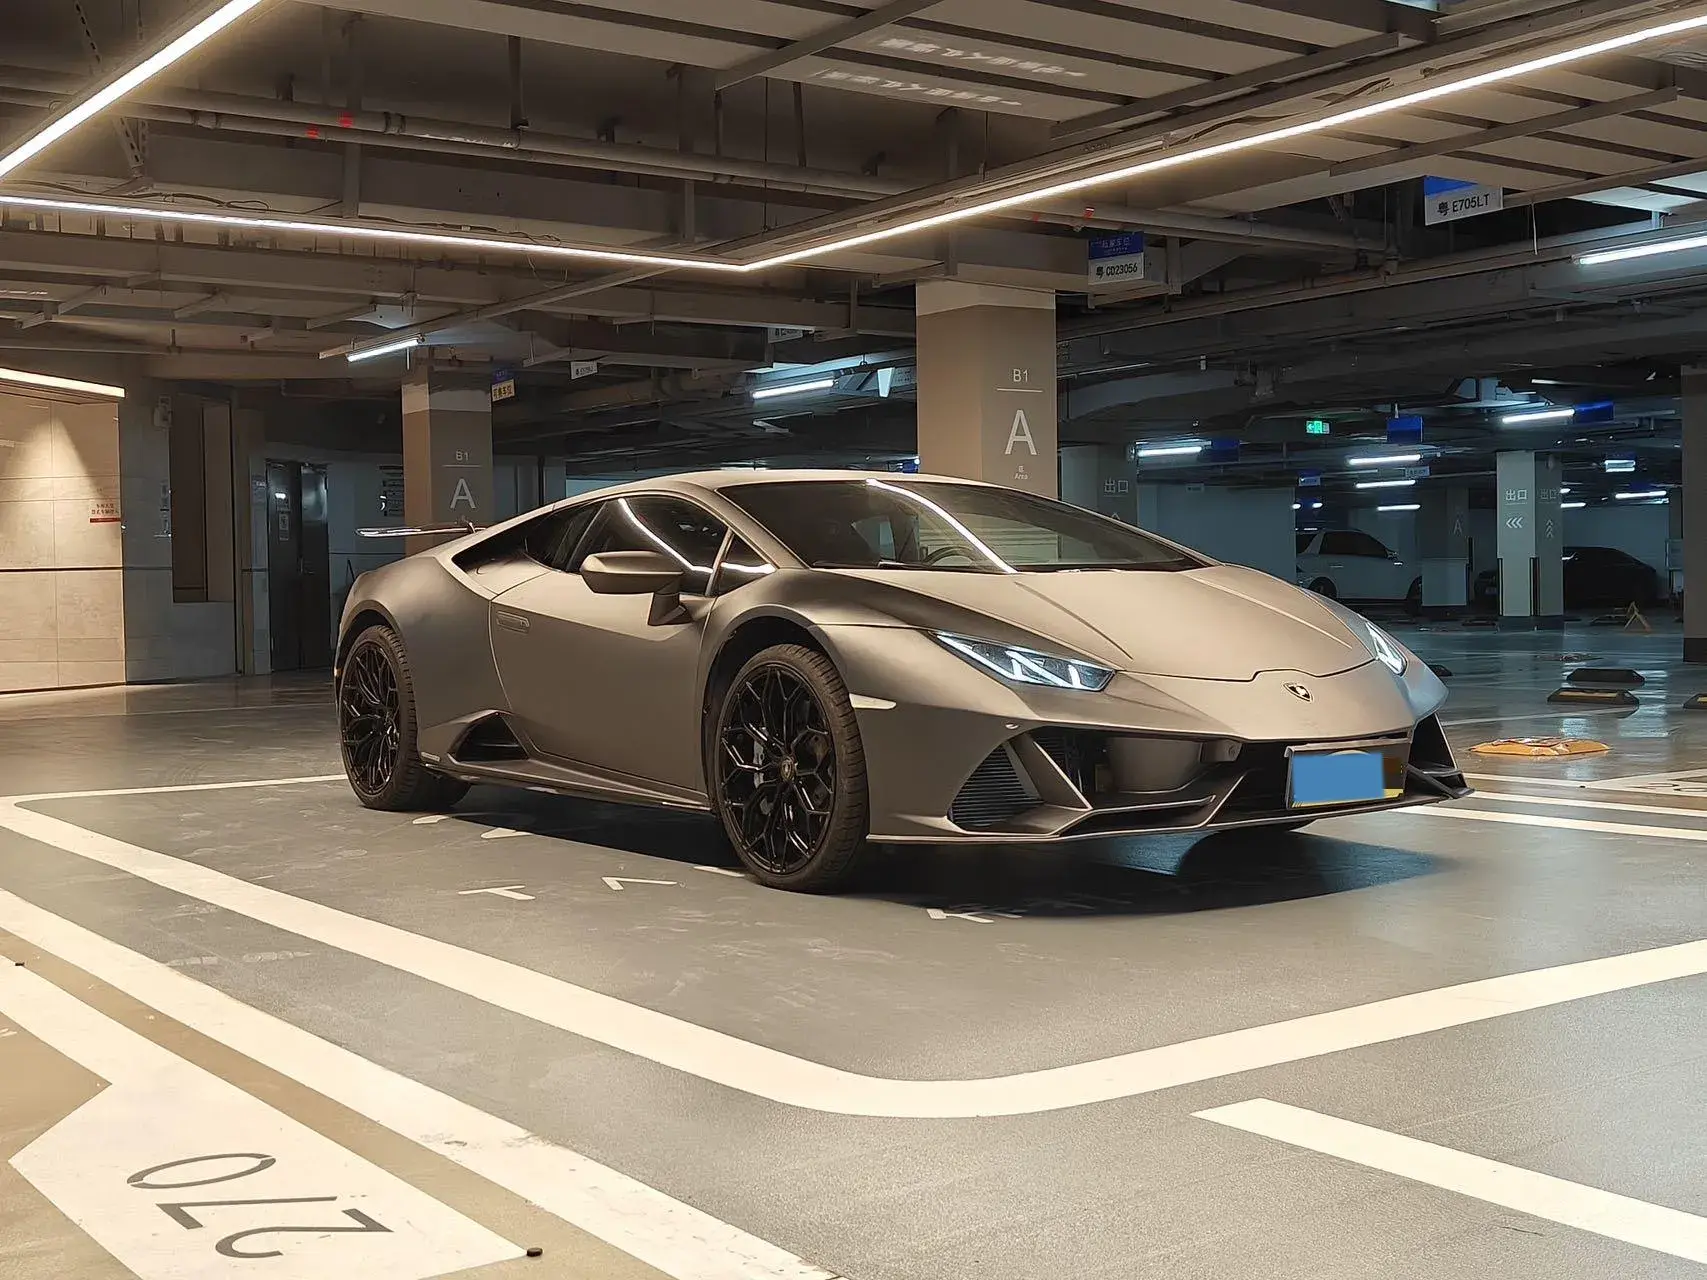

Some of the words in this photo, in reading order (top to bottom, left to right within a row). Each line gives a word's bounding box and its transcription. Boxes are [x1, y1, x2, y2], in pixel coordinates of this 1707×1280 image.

[1452, 194, 1490, 213] E705LT
[1013, 369, 1028, 382] B1
[1005, 409, 1037, 455] A
[456, 449, 469, 461] B1
[450, 478, 476, 509] A
[1104, 477, 1128, 493] 出口
[1505, 488, 1528, 501] 出口
[126, 1152, 394, 1259] 270
